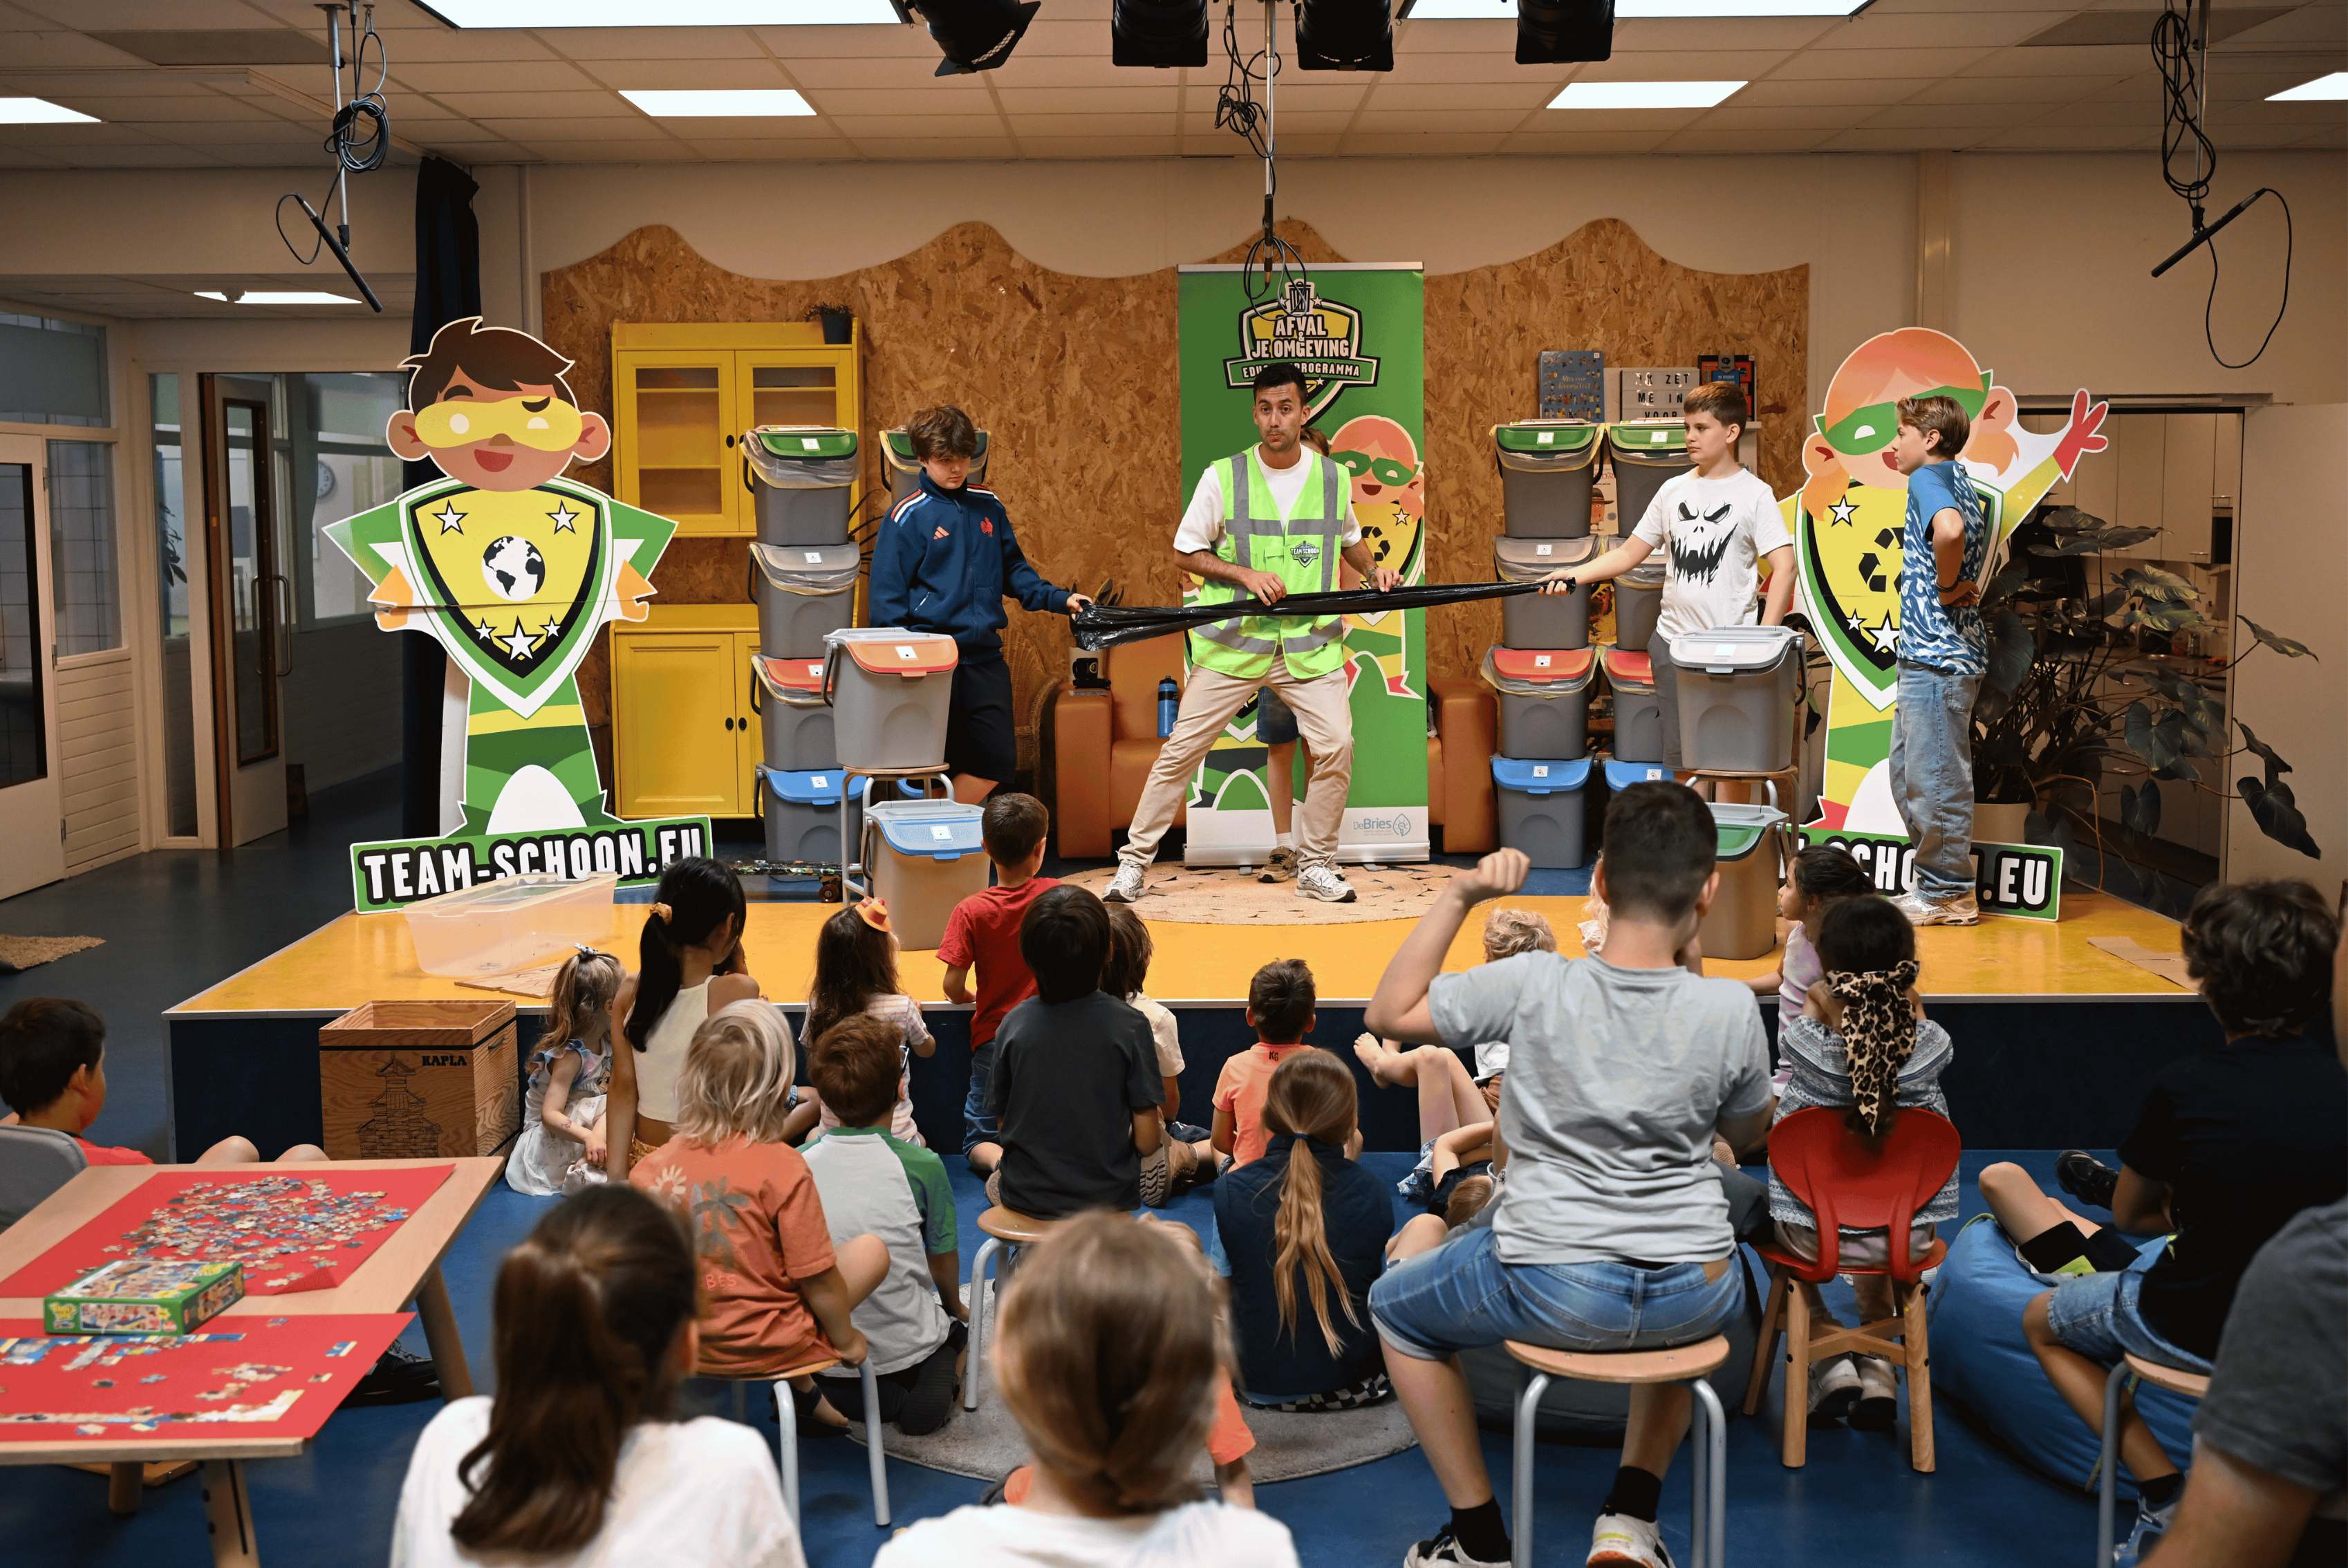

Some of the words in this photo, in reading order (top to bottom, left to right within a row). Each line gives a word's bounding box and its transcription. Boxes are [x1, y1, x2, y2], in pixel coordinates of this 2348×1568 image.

[1275, 315, 1327, 337] AFVAL
[1298, 331, 1305, 342] &
[1251, 340, 1269, 358] JE
[1274, 339, 1349, 358] OMGEVING
[1665, 373, 1689, 384] ZET
[1638, 392, 1655, 403] ME
[1668, 393, 1683, 403] IN
[1353, 818, 1392, 830] DeBries
[364, 828, 701, 899] TEAM-SCHOON.EU
[422, 1055, 467, 1067] KAPLA
